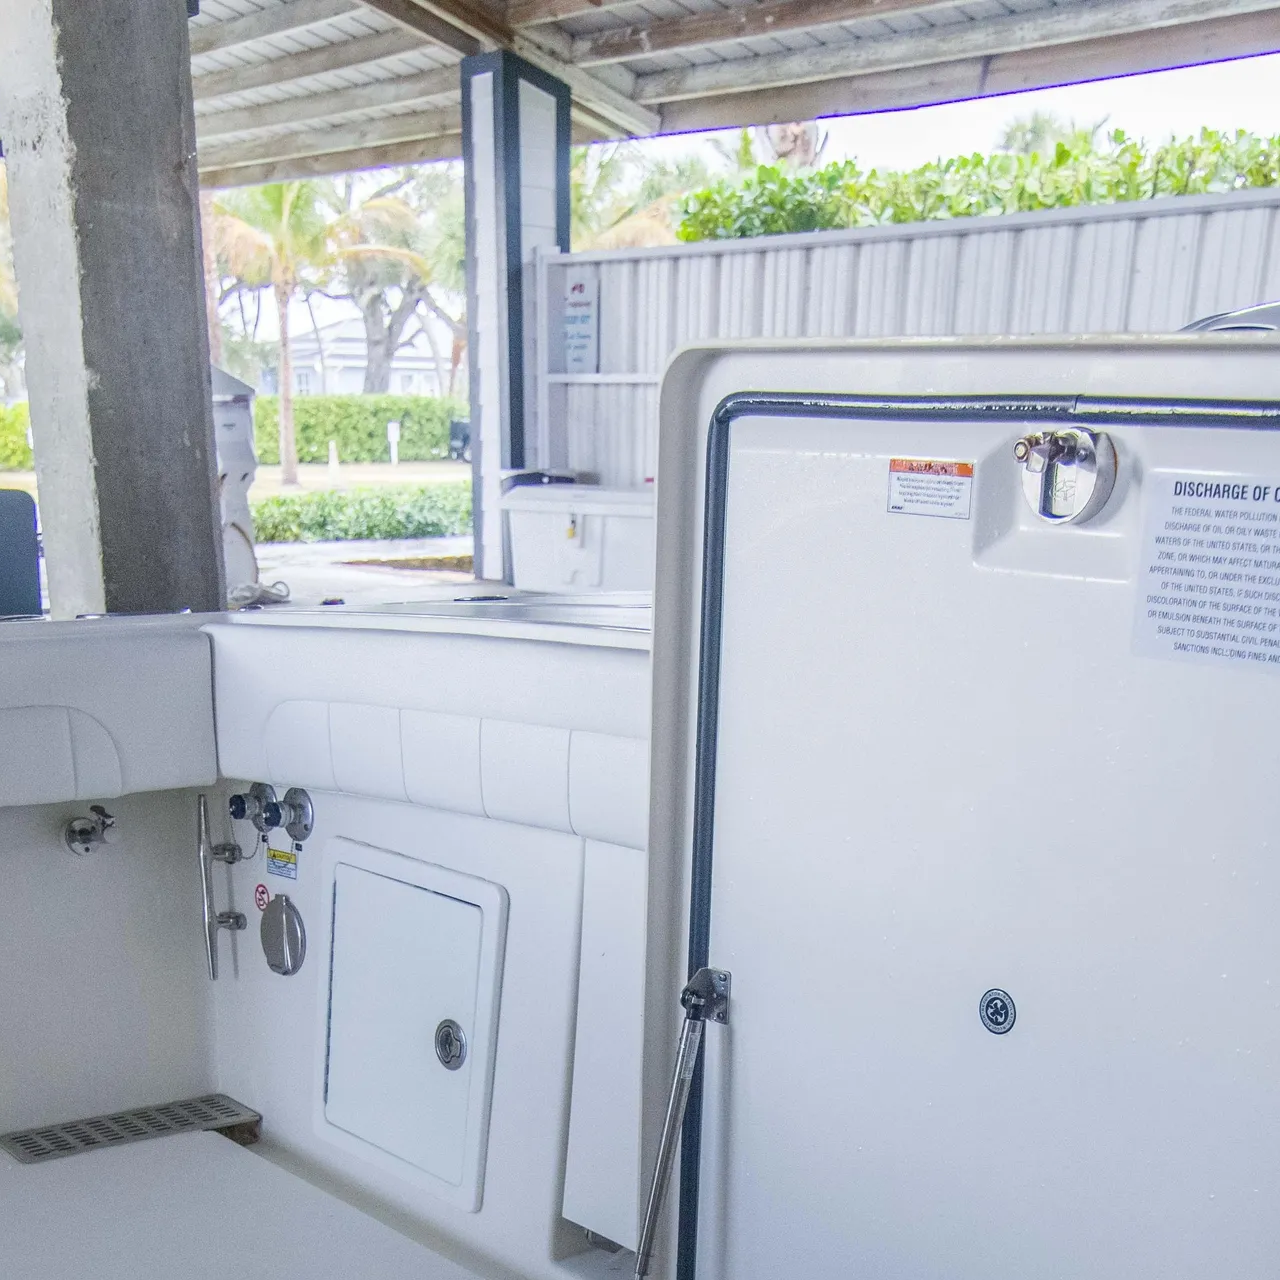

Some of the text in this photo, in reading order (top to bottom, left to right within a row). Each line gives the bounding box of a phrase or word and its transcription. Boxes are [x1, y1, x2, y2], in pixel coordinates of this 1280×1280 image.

[1174, 481, 1248, 500] DISCHARGE
[1253, 486, 1271, 501] OF
[1172, 506, 1183, 515] THE
[1184, 508, 1212, 517] FEDERAL
[1215, 510, 1238, 519] WATER
[1240, 512, 1277, 521] POLLUTION
[1165, 522, 1201, 532] DISCHARGE
[1203, 524, 1210, 533] OF
[1213, 525, 1222, 534] OIL
[1225, 526, 1234, 535] OR
[1236, 527, 1251, 536] OILY
[1254, 529, 1277, 538] WASTE
[1155, 536, 1181, 545] WATERS
[1182, 538, 1191, 546] OF
[1193, 539, 1204, 548] THE
[1206, 540, 1230, 550] UNITED
[1232, 542, 1258, 553] STATES,
[1260, 545, 1270, 553] OR
[1158, 551, 1176, 561] ZONE,
[1189, 554, 1210, 563] WHICH
[1212, 556, 1227, 564] MAY
[1228, 558, 1252, 567] AFFECT
[1149, 565, 1194, 577] APPERTAINING
[1208, 571, 1218, 579] OR
[1220, 572, 1242, 581] UNDER
[1244, 575, 1256, 584] THE
[1161, 581, 1170, 589] OF
[1171, 582, 1182, 591] THE
[1184, 584, 1208, 594] UNITED
[1244, 590, 1263, 599] SUCH
[1147, 595, 1197, 608] DISCOLORATION
[1199, 600, 1207, 609] OF
[1209, 602, 1220, 610] THE
[1223, 603, 1252, 614] SURFACE
[1254, 606, 1262, 615] OF
[1264, 607, 1276, 616] THE
[1148, 610, 1157, 618] OR
[1158, 611, 1191, 622] EMULSION
[1193, 614, 1221, 625] BENEATH
[1223, 618, 1235, 627] THE
[1237, 620, 1266, 631] SURFACE
[1268, 624, 1278, 632] OF
[1157, 626, 1185, 636] SUBJECT
[1187, 629, 1195, 637] TO
[1196, 630, 1240, 643] SUBSTANTIAL
[1241, 635, 1258, 645] CIVIL
[1173, 642, 1209, 654] SANCTIONS
[1248, 652, 1267, 662] FINES
